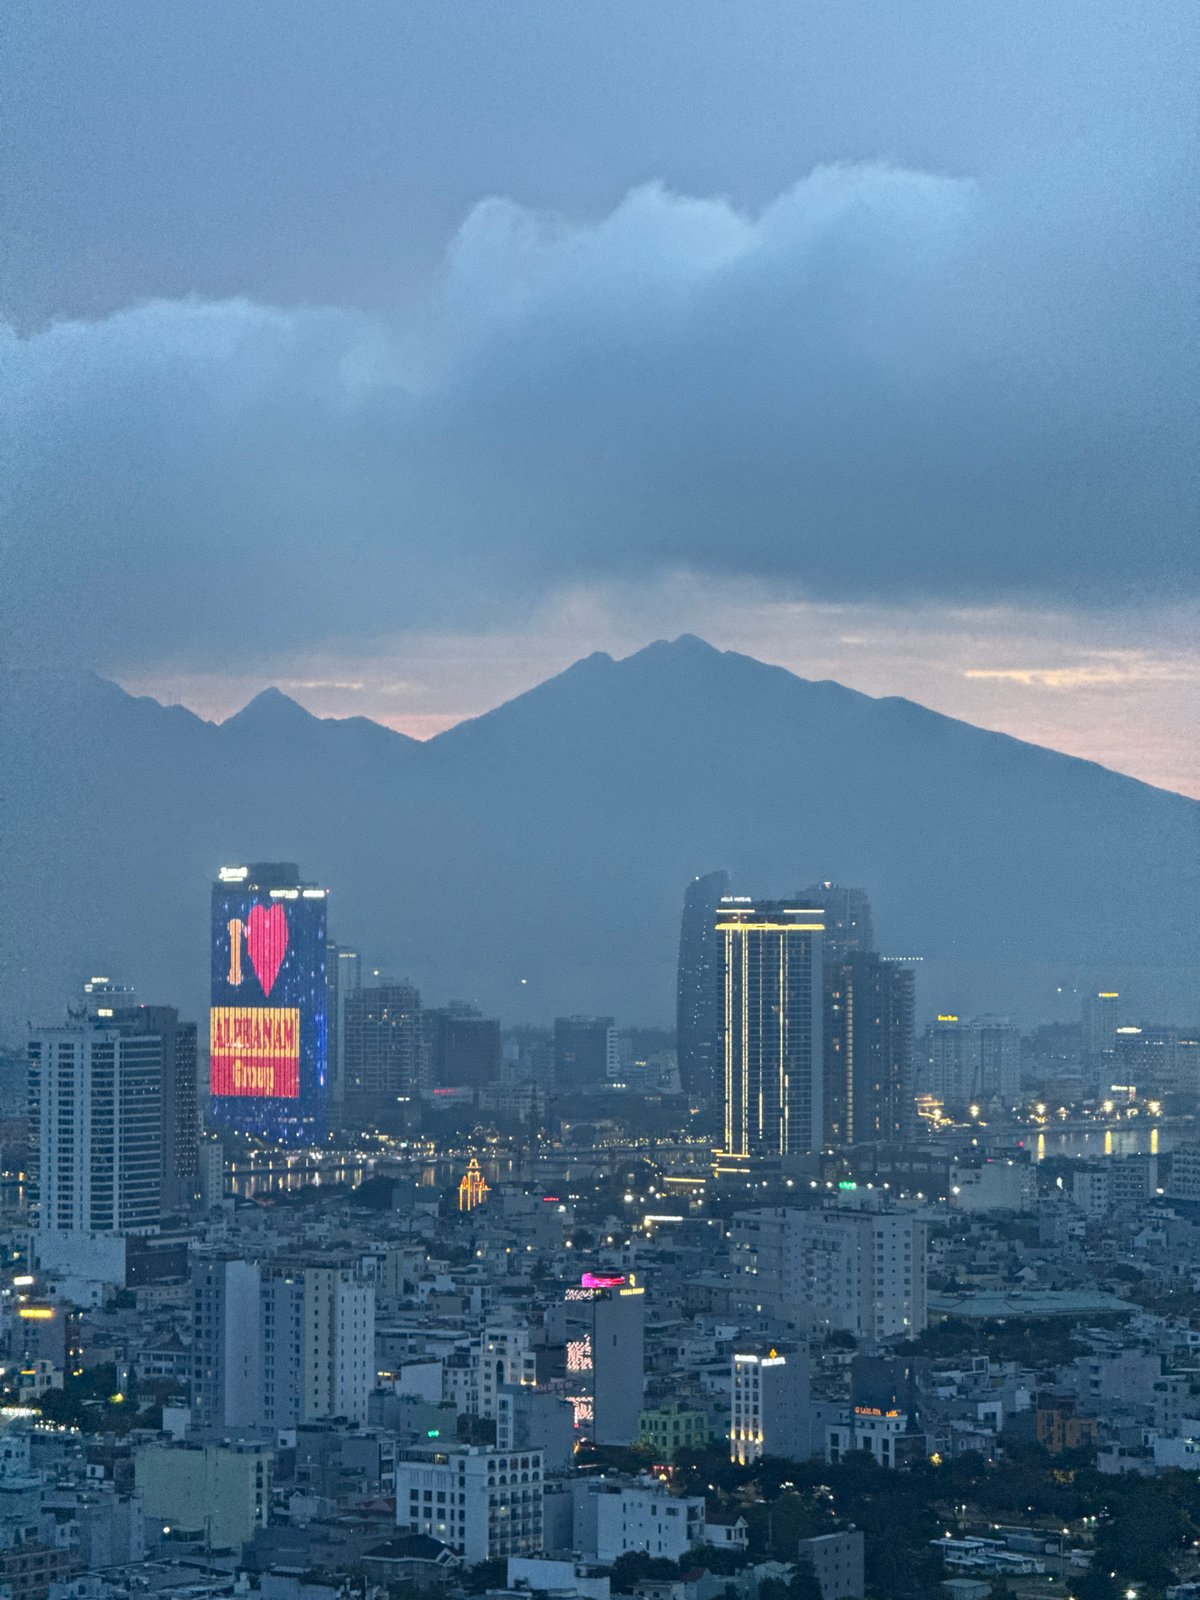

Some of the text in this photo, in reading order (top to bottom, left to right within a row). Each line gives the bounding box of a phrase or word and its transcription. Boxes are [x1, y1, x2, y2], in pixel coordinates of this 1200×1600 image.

[227, 918, 244, 985] I
[214, 1018, 295, 1049] ALPHANAM
[232, 1058, 275, 1095] Group
